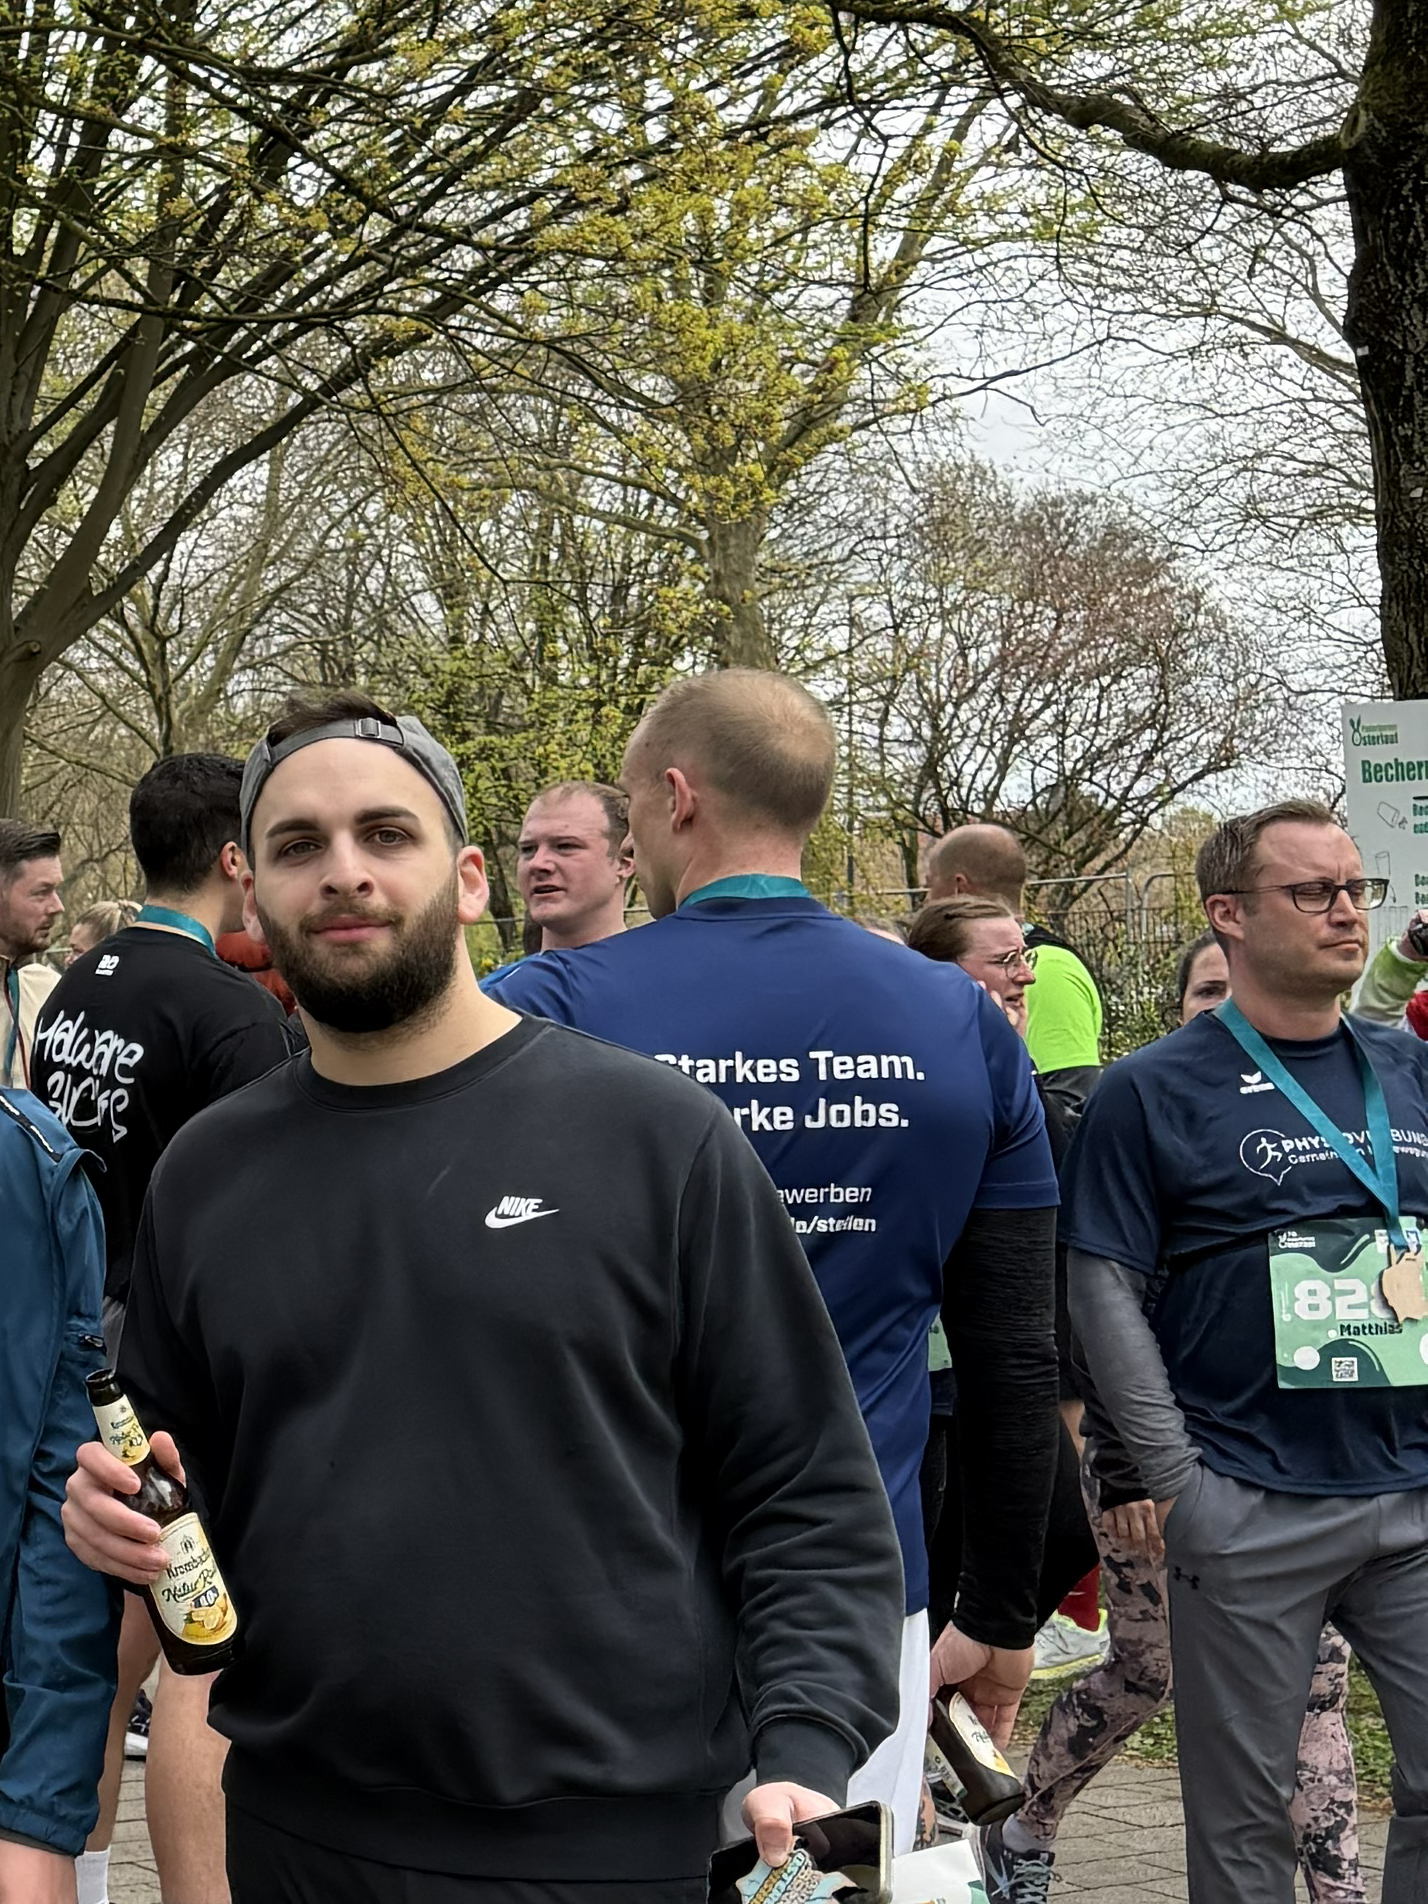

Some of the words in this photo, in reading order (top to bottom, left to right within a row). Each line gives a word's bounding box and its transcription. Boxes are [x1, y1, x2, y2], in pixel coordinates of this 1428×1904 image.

[808, 1050, 926, 1081] Team.
[804, 1095, 910, 1129] Jobs.
[497, 1195, 543, 1217] NIKE
